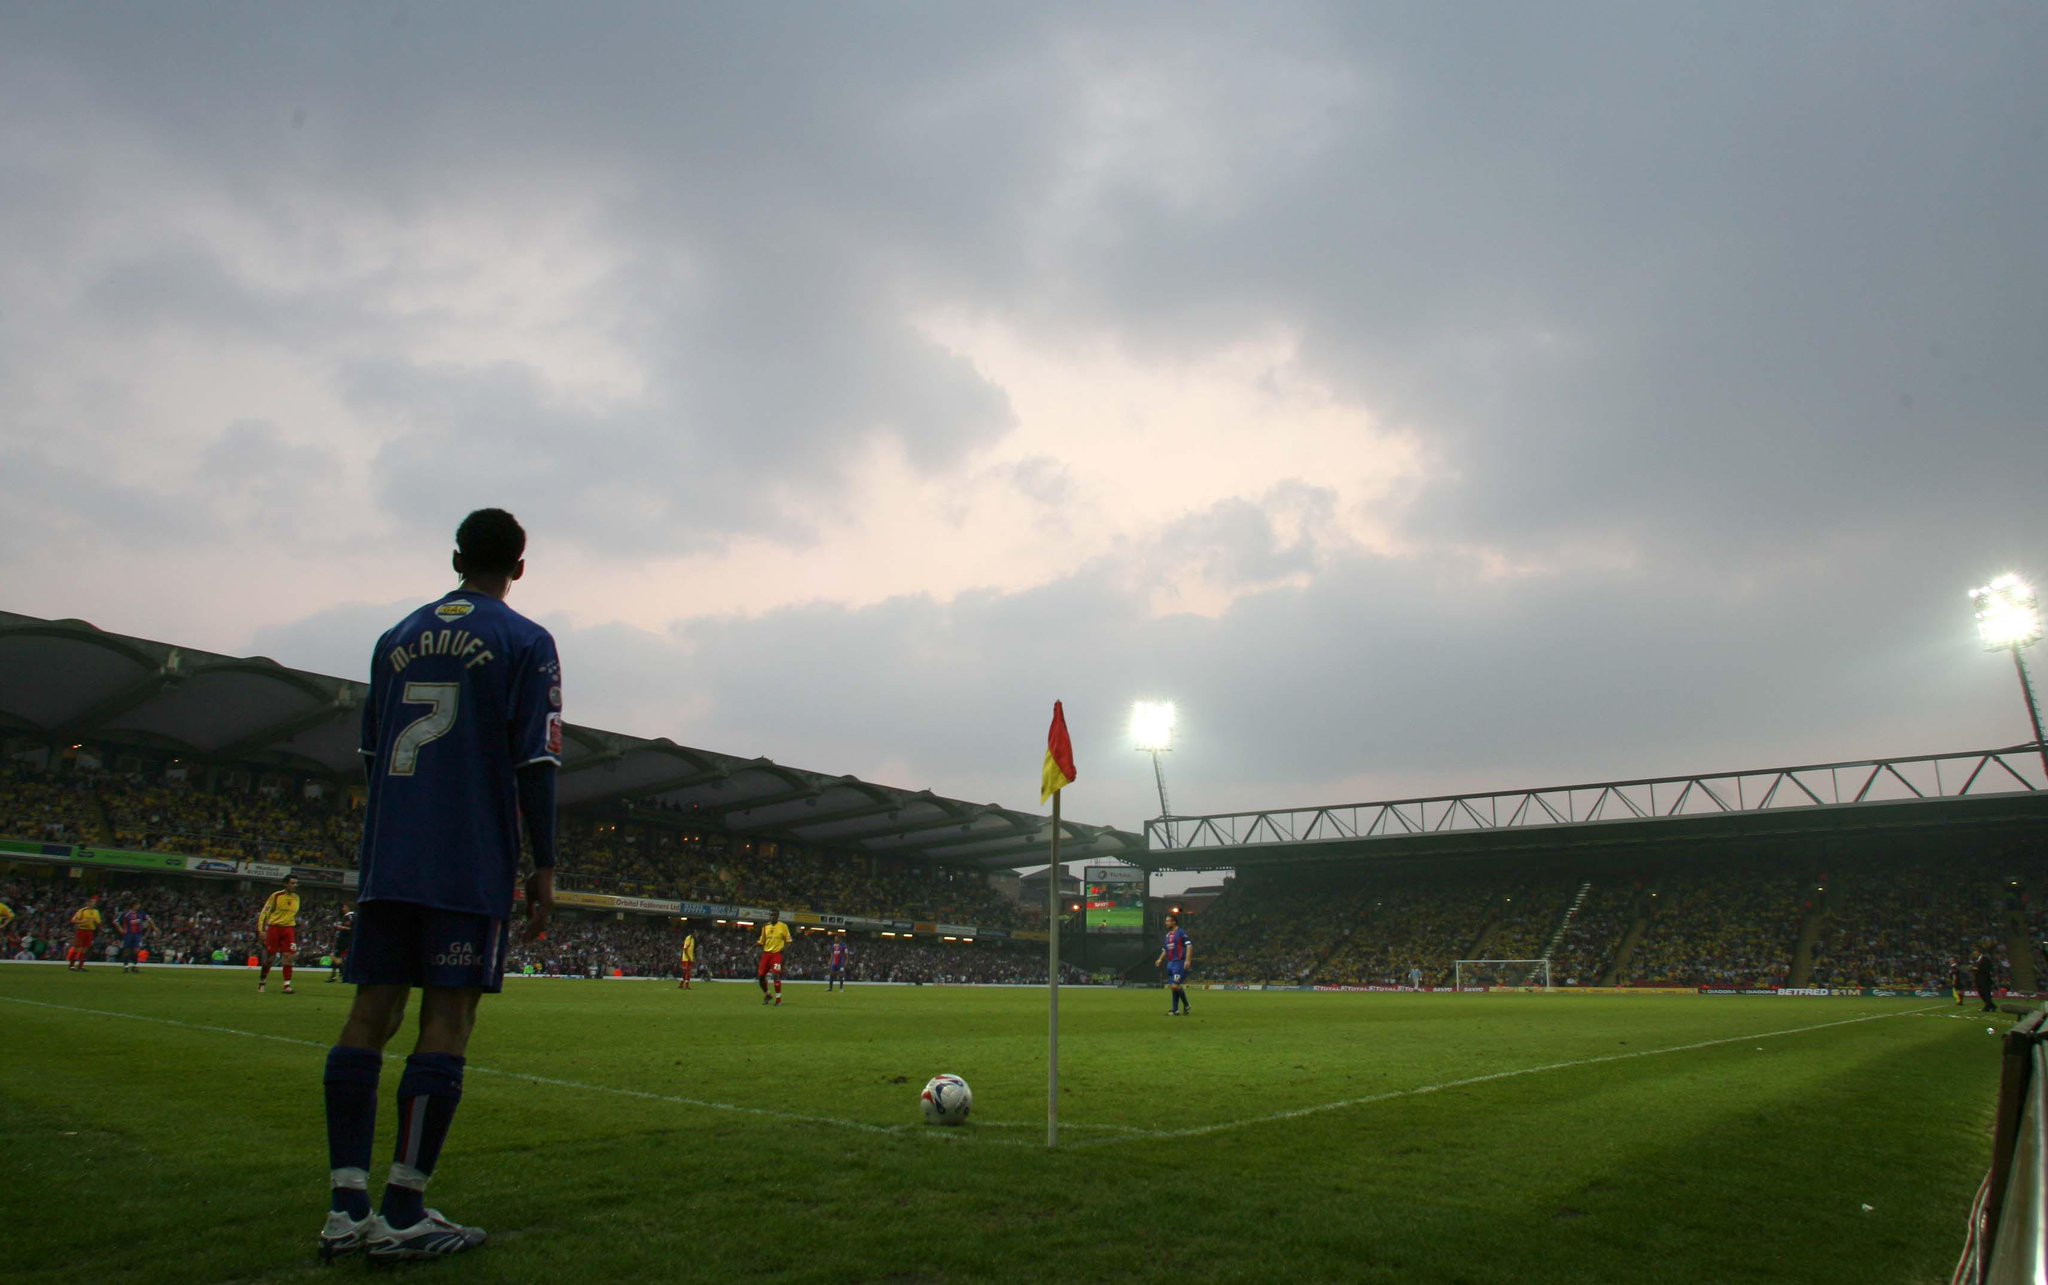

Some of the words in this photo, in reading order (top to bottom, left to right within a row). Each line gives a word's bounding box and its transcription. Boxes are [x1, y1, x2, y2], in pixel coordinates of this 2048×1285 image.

[388, 681, 461, 776] 7
[616, 899, 639, 907] Orbital
[640, 900, 669, 909] Fasteners
[670, 903, 680, 911] Ltd
[1777, 988, 1829, 996] BETFRED
